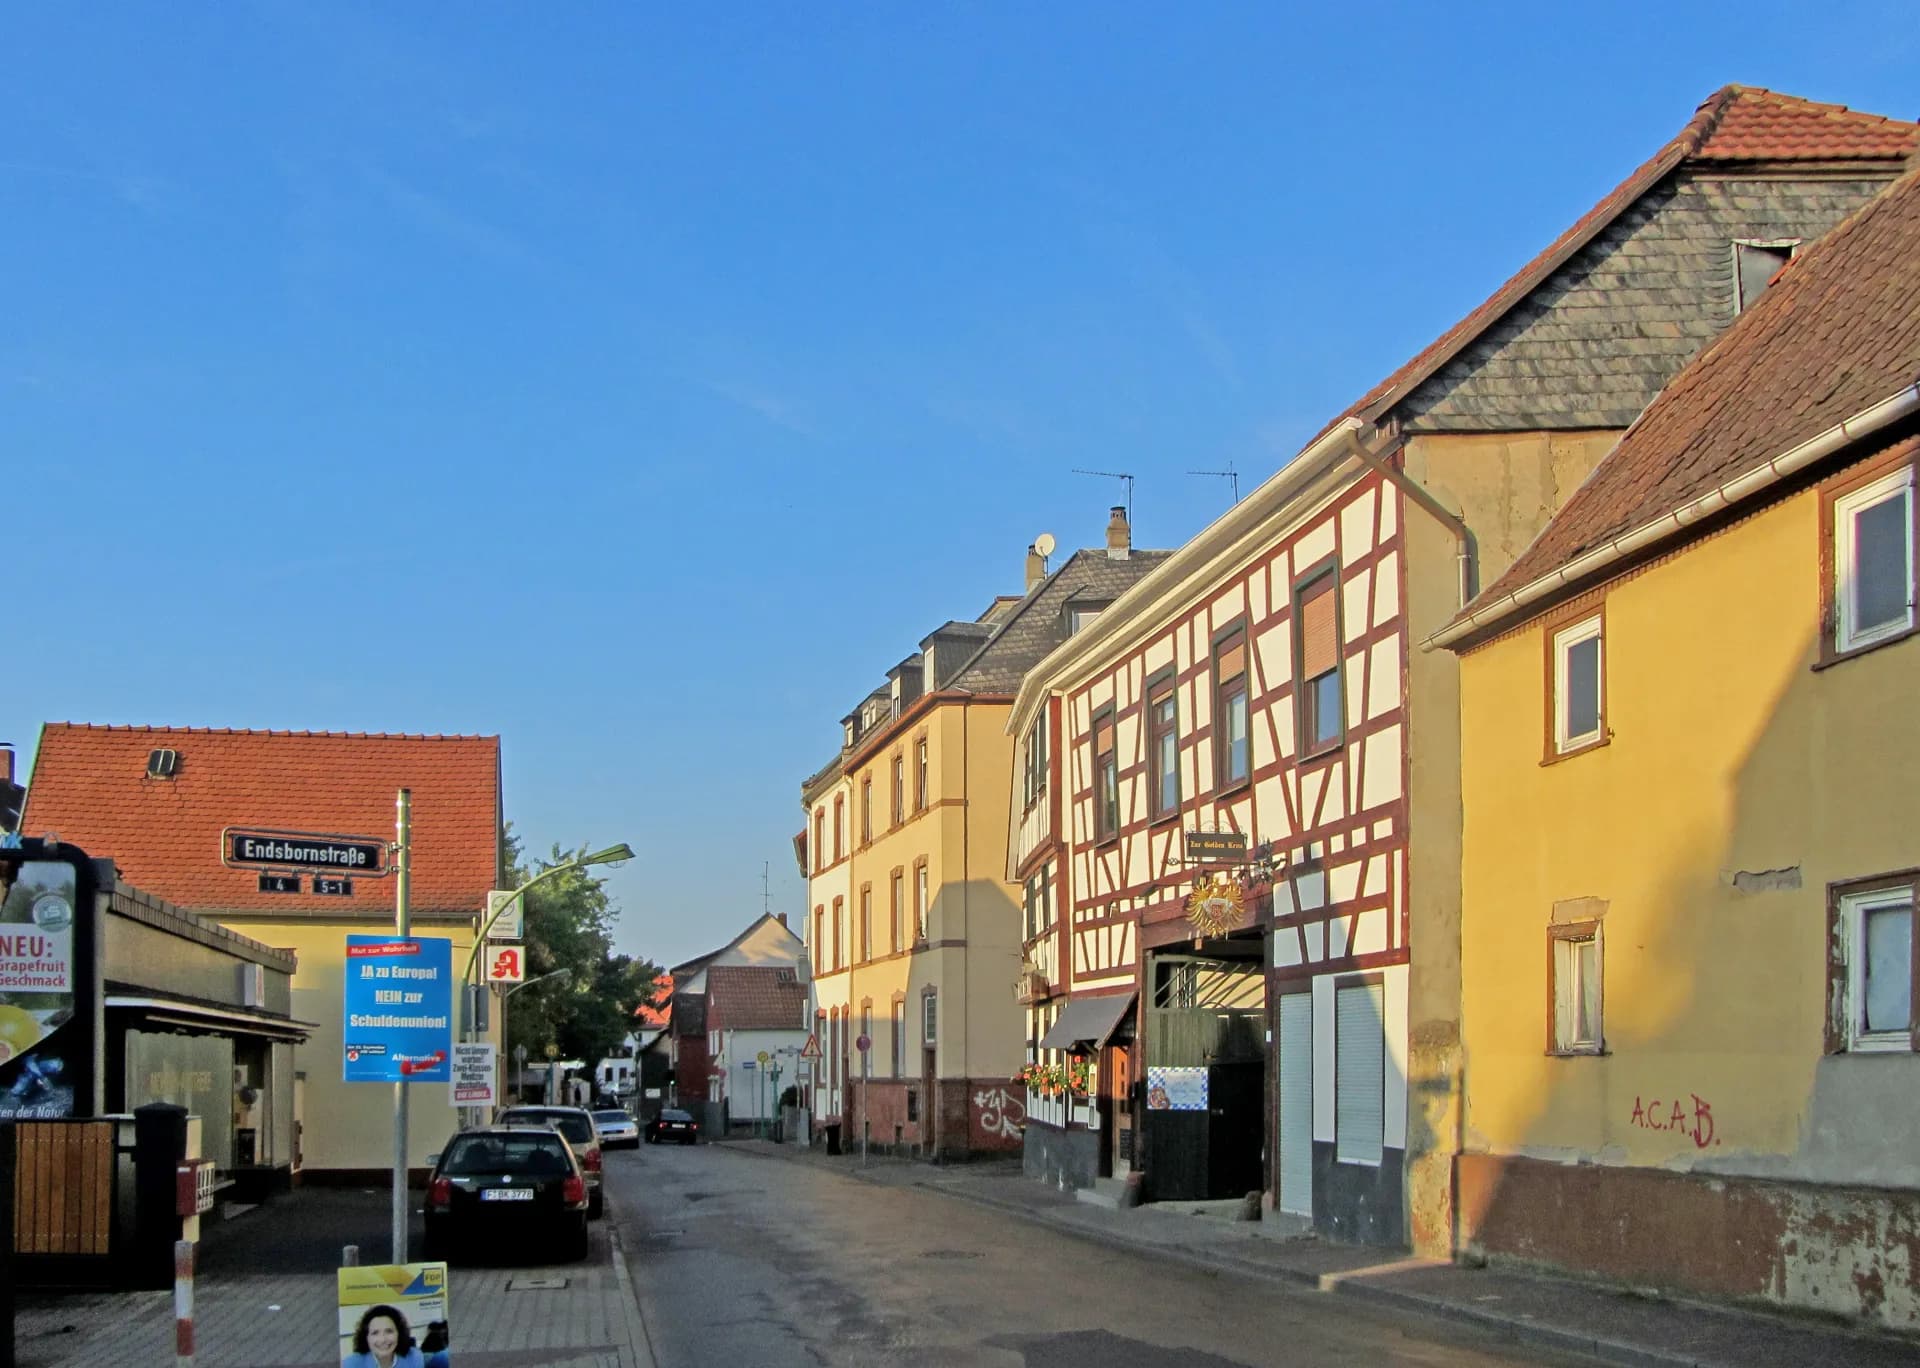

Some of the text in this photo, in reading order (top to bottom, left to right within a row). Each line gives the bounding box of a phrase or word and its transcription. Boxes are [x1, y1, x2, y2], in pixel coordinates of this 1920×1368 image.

[244, 839, 366, 866] Endsbornstraße
[0, 935, 53, 958] NEU:
[382, 945, 417, 953] Wahrheit
[360, 965, 437, 980] JA zu Europa!
[375, 990, 423, 1004] NEIN zur
[350, 1014, 447, 1028] Schuldenunion!
[392, 1053, 440, 1062] Alternative
[0, 1108, 14, 1119] en
[16, 1105, 32, 1118] der
